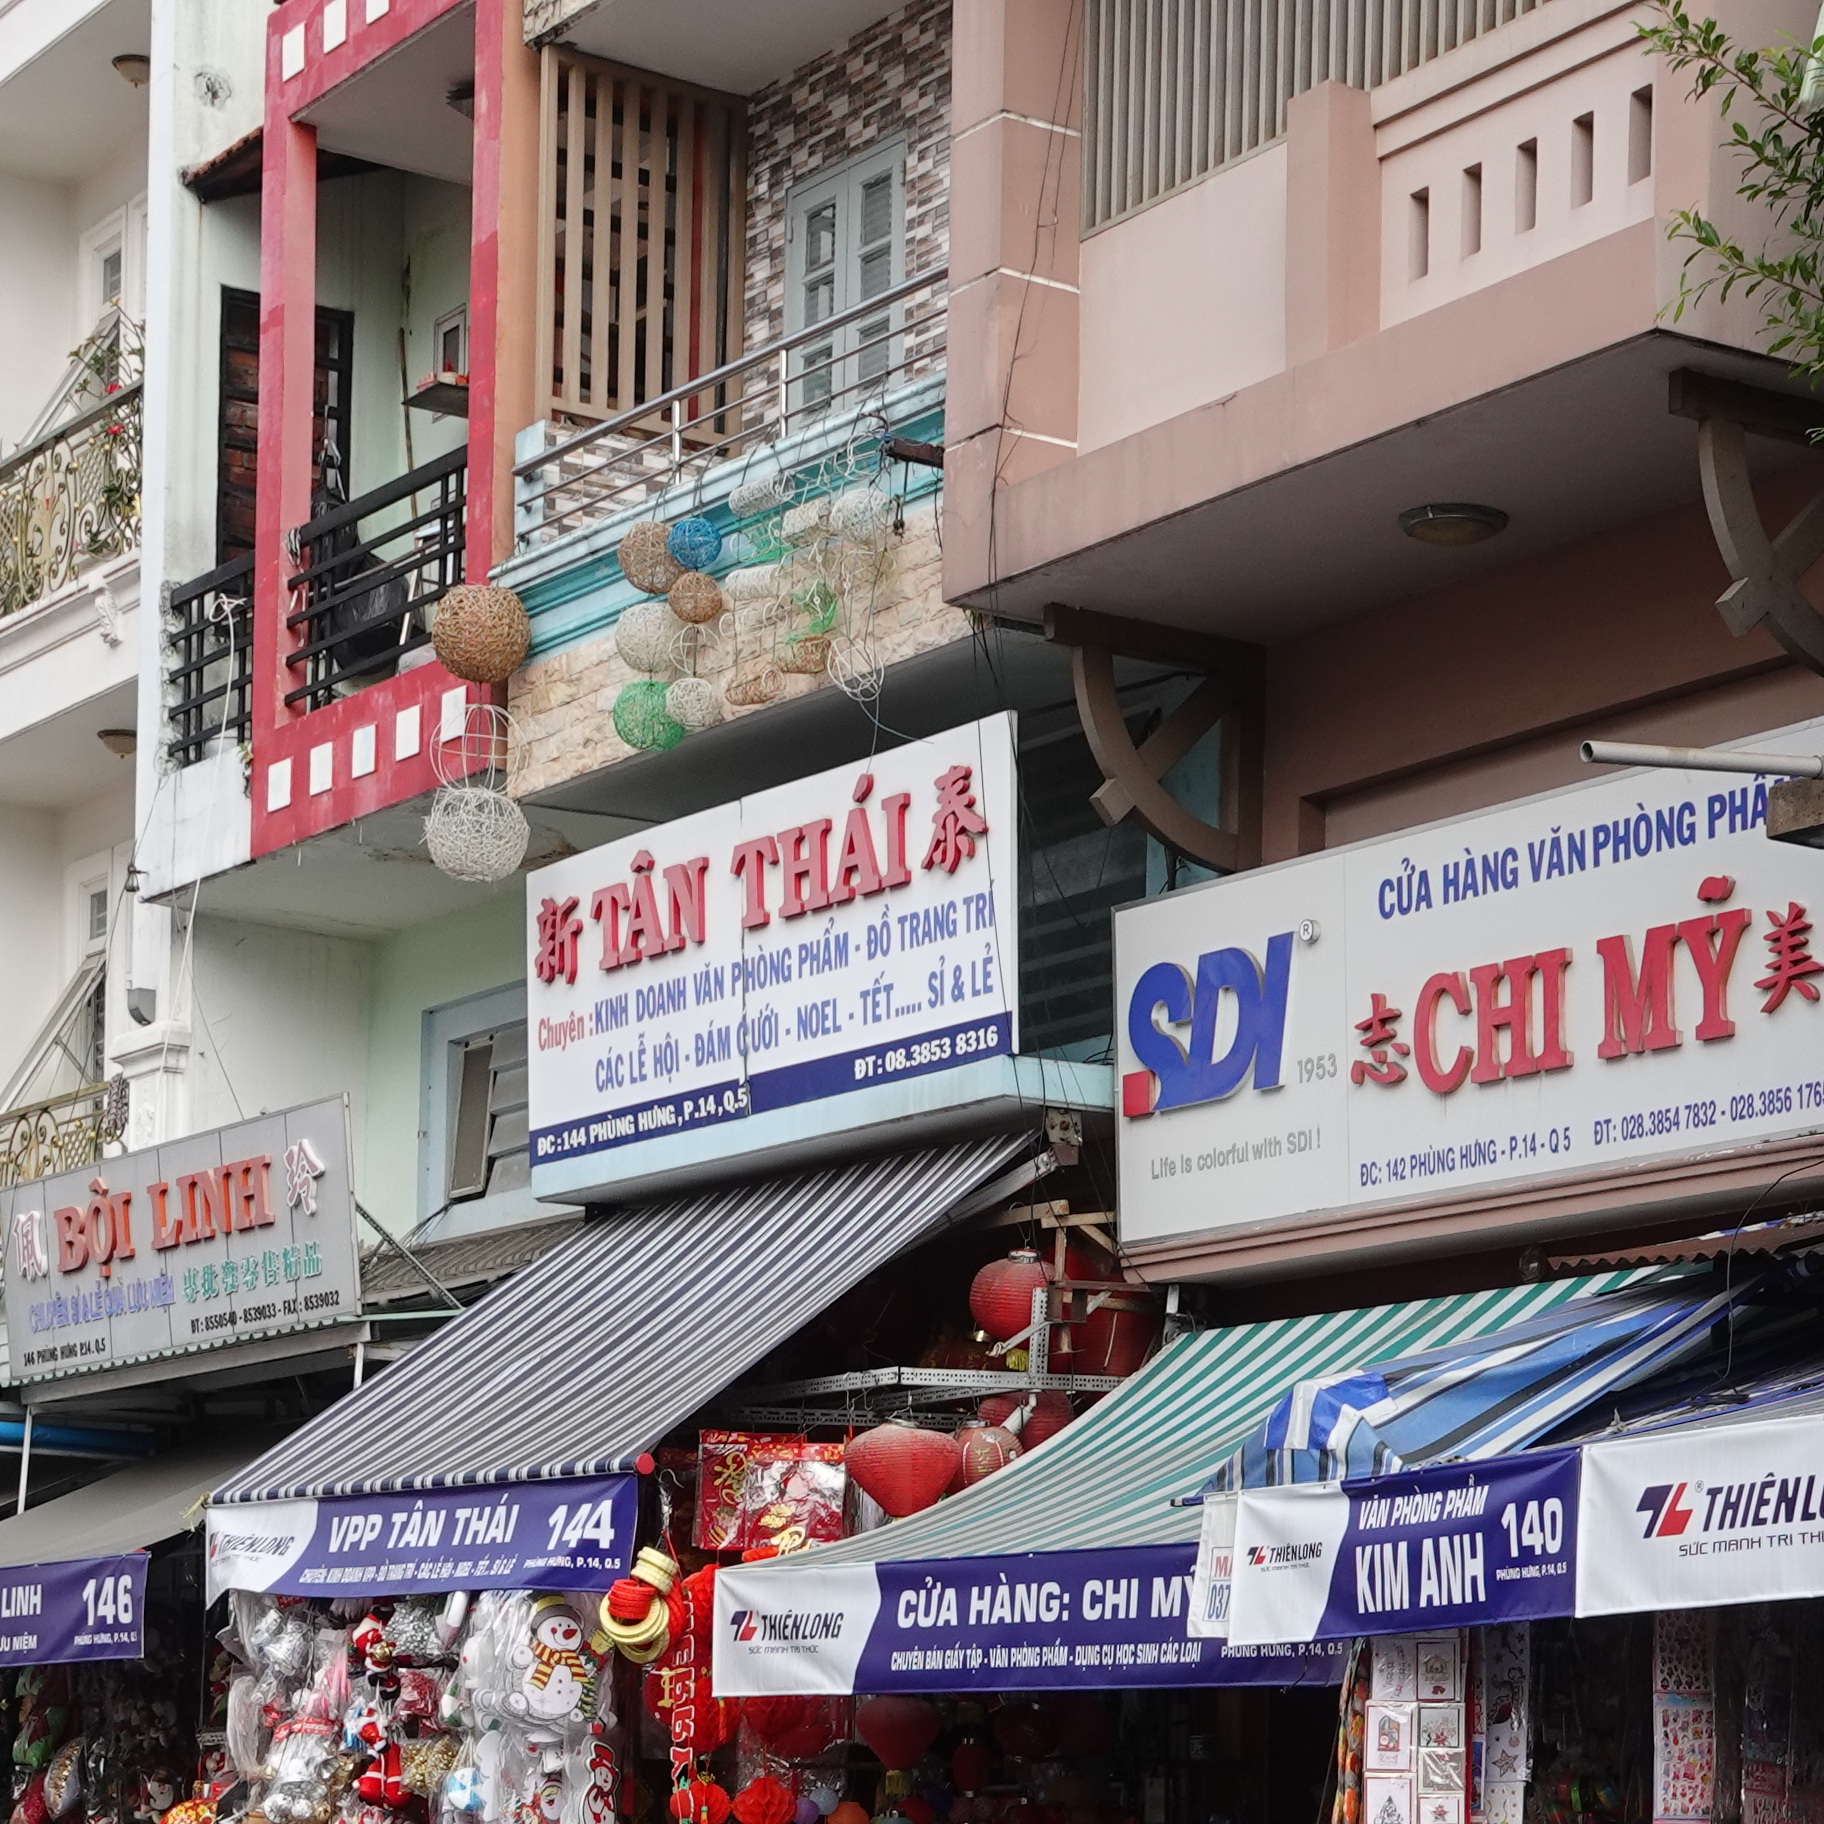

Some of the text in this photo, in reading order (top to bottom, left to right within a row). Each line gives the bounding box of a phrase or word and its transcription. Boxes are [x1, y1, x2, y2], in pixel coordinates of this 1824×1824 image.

[921, 764, 989, 875] 泰
[589, 773, 912, 971] TÂN THÁI
[1378, 857, 1432, 920] CỬA
[1442, 846, 1519, 905] HÀNG
[1528, 825, 1587, 883] VĂN
[1593, 802, 1697, 869] PHÒNG
[534, 896, 584, 985] 新
[538, 879, 995, 1052] Chuyên KINH DOANH VĂN PHÒNG PHẨM ĐỒ TRANG TRÍ
[1128, 930, 1297, 1112] SDI
[1413, 875, 1753, 1095] CHI MỸ
[1297, 1053, 1338, 1084] 1953
[1350, 993, 1411, 1086] 志
[1386, 1156, 1407, 1183] 142
[1409, 1145, 1456, 1179] PHÙNG
[1459, 1137, 1497, 1170] HƯNG
[1509, 1134, 1538, 1161] P.14
[53, 1154, 275, 1278] BỘI LINH
[327, 1493, 521, 1554] VPP TÂN THÁI
[547, 1499, 615, 1551] 144
[1358, 1473, 1490, 1531] VĂN PHÒNG PHẨM
[1501, 1497, 1563, 1559] 140
[1, 1584, 43, 1616] LINH
[82, 1574, 134, 1627] 146
[896, 1575, 959, 1629] CỬA
[969, 1571, 1070, 1627] HÀNG:
[1082, 1576, 1140, 1621] CHI
[1355, 1532, 1487, 1614] KIM ANH
[12, 1633, 37, 1655] NIỆM
